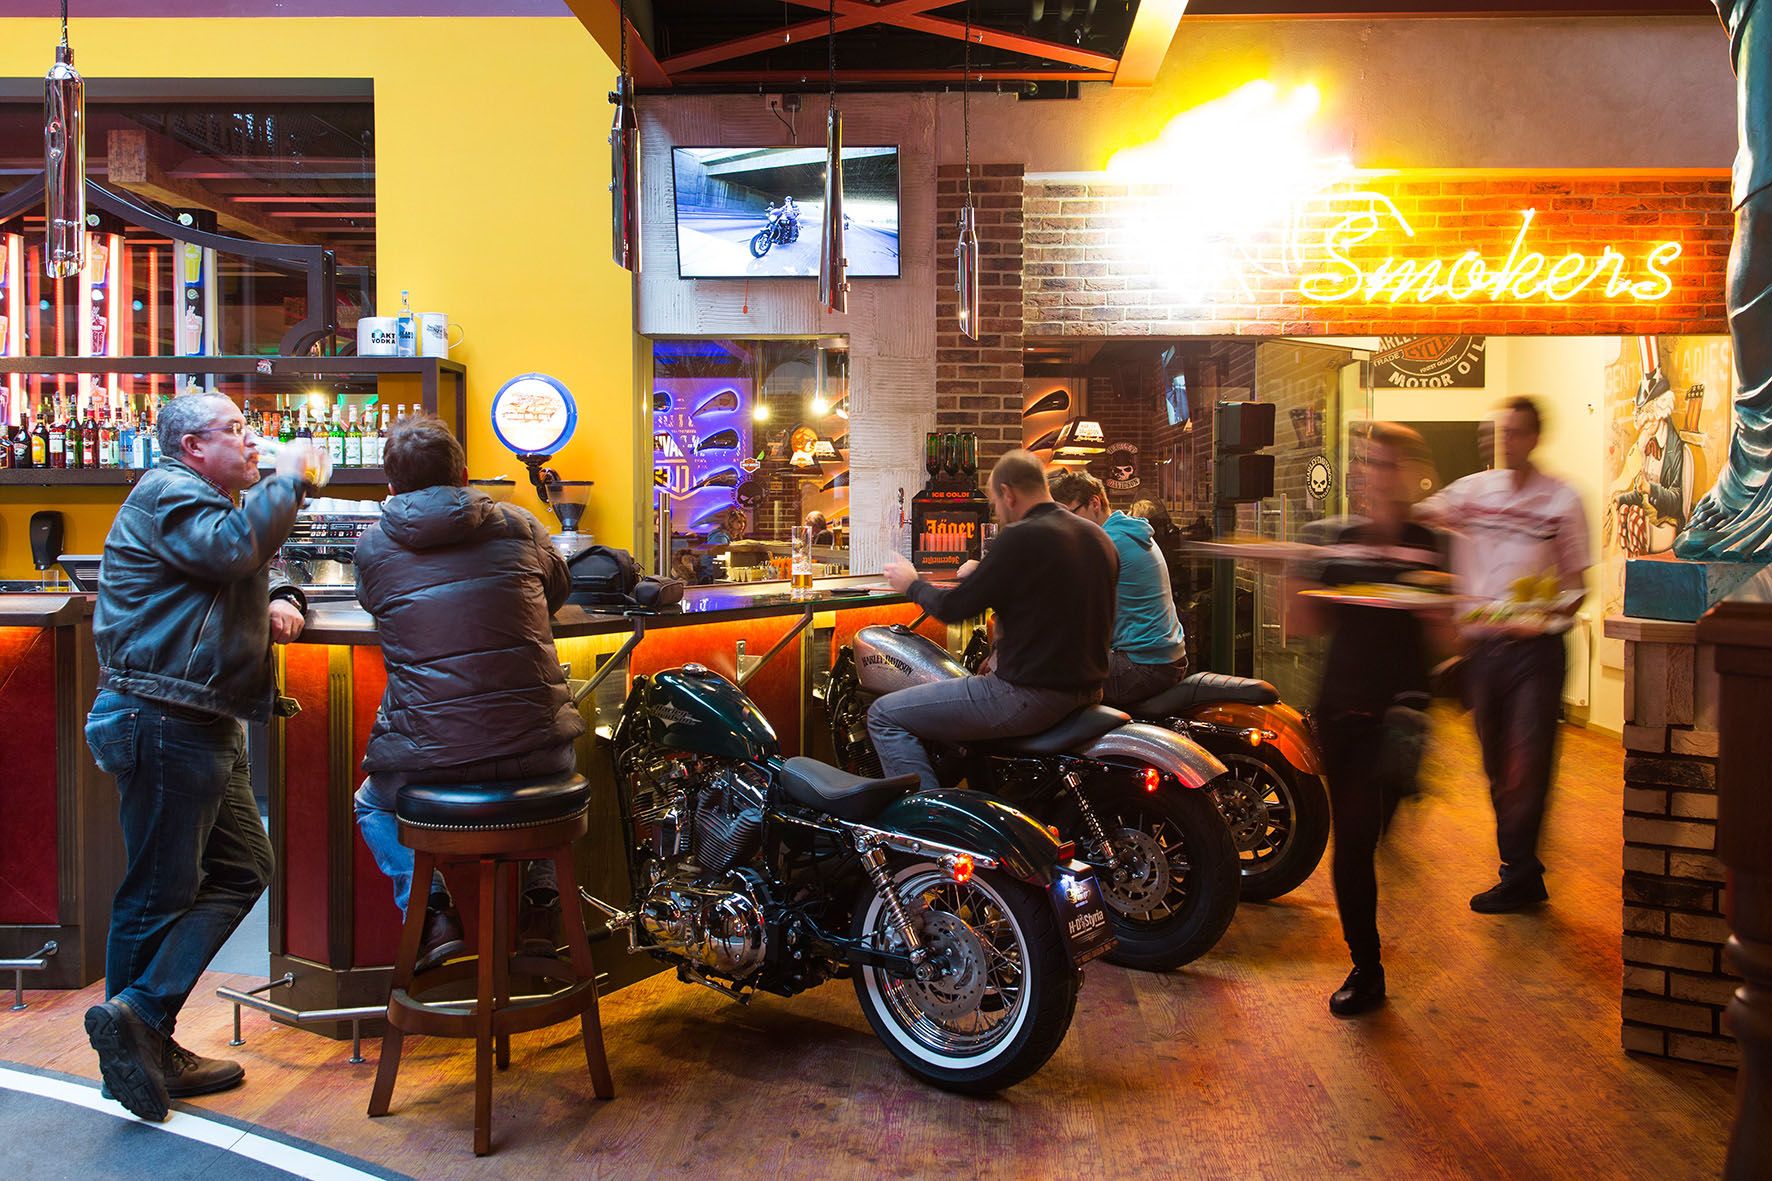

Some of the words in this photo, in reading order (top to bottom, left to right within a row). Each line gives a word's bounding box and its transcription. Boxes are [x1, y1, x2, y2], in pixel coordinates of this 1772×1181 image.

[1300, 206, 1683, 302] Smokers
[1373, 353, 1400, 367] TRADE
[1388, 371, 1454, 388] MOTOR
[1458, 340, 1486, 375] OIL
[1083, 909, 1104, 928] Styria
